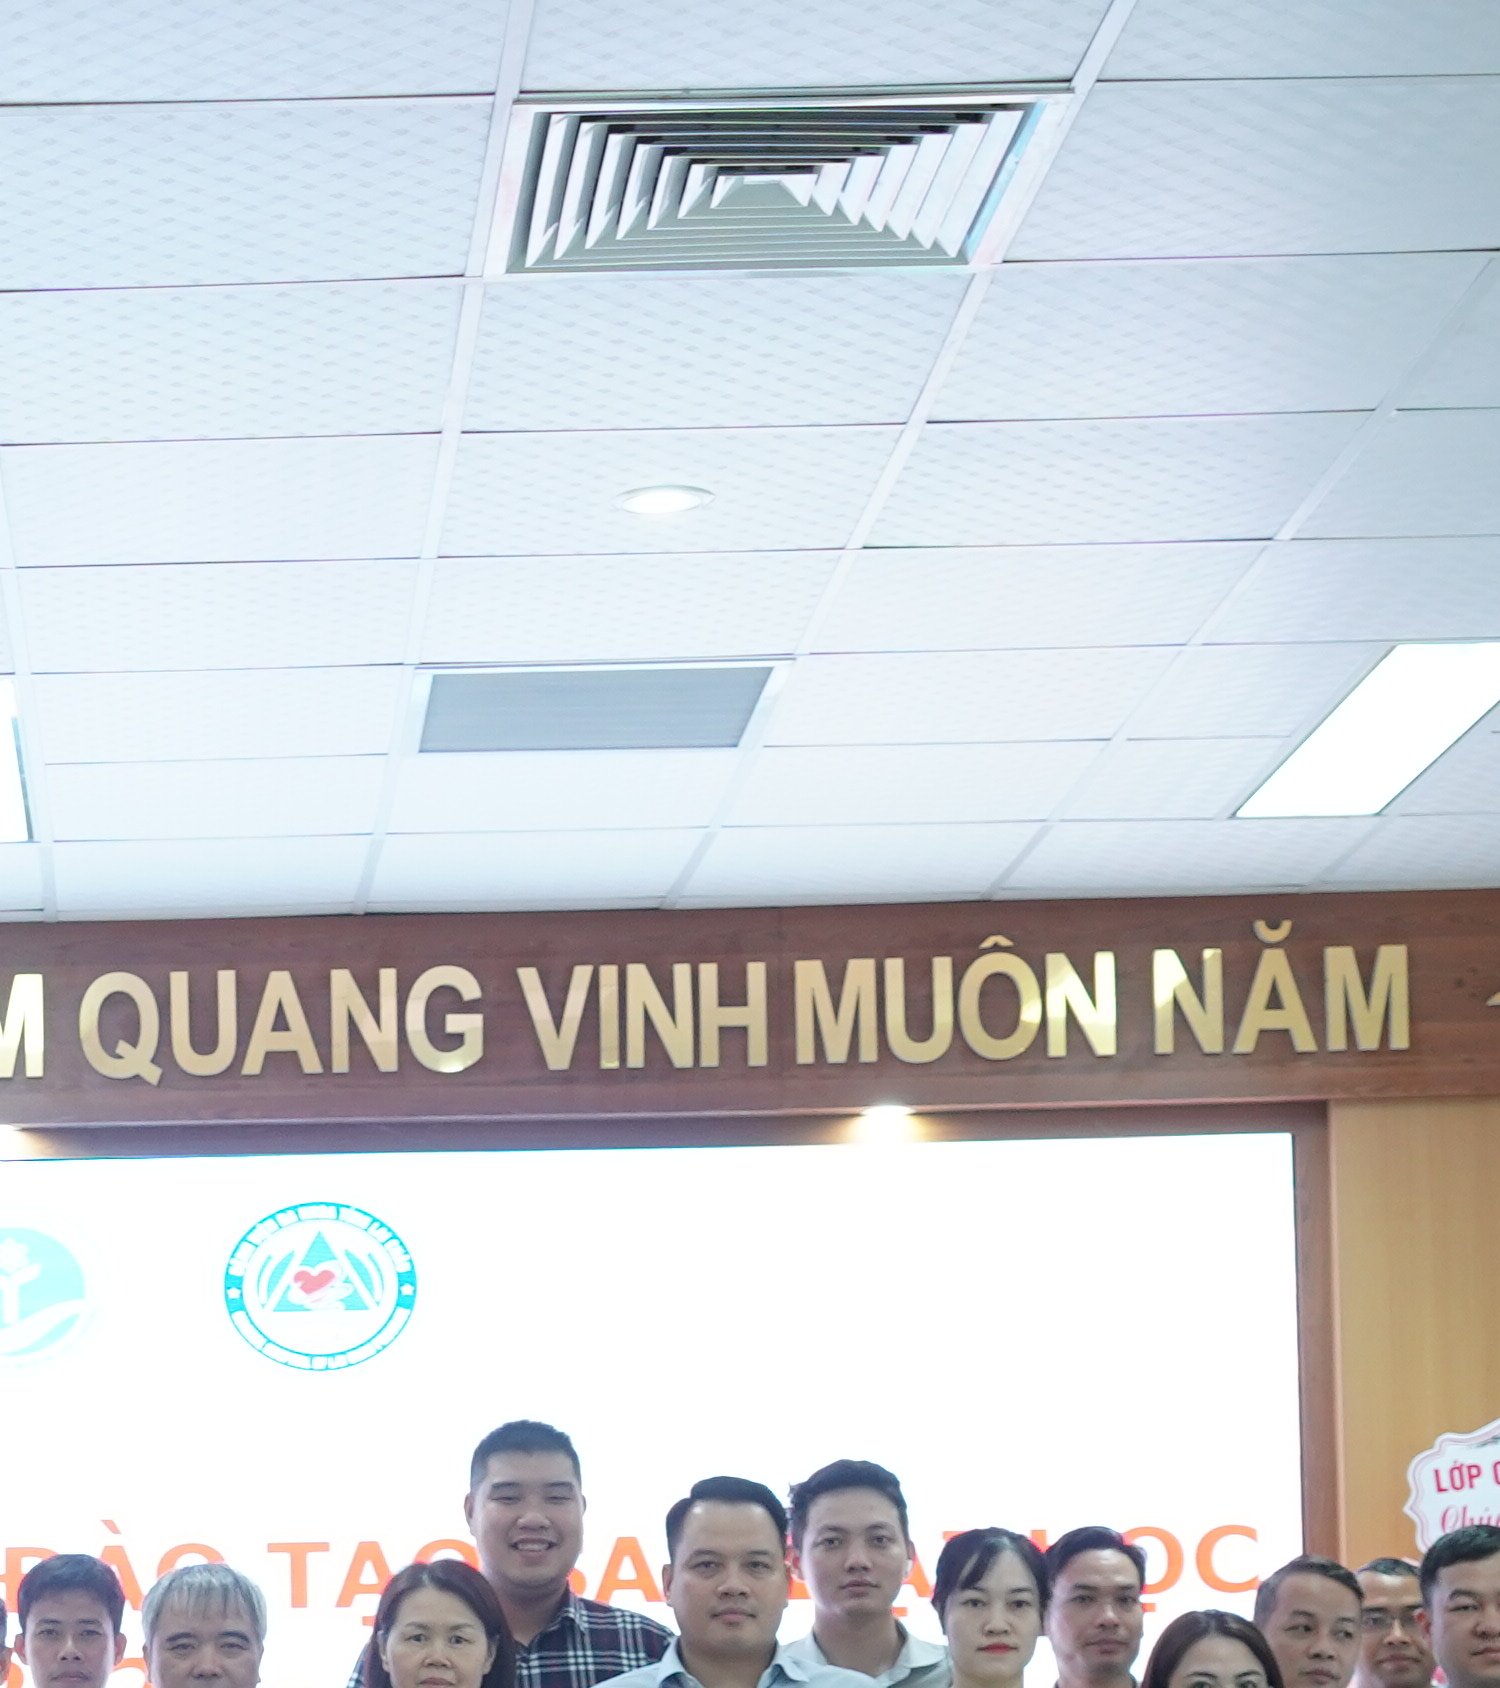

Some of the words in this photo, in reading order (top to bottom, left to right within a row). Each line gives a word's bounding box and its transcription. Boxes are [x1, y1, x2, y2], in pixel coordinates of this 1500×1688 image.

[78, 964, 485, 1087] QUANG
[516, 961, 769, 1071] VINH
[794, 934, 1118, 1065] MUÔN
[1151, 919, 1411, 1056] NĂM
[1434, 1460, 1482, 1493] LỚP
